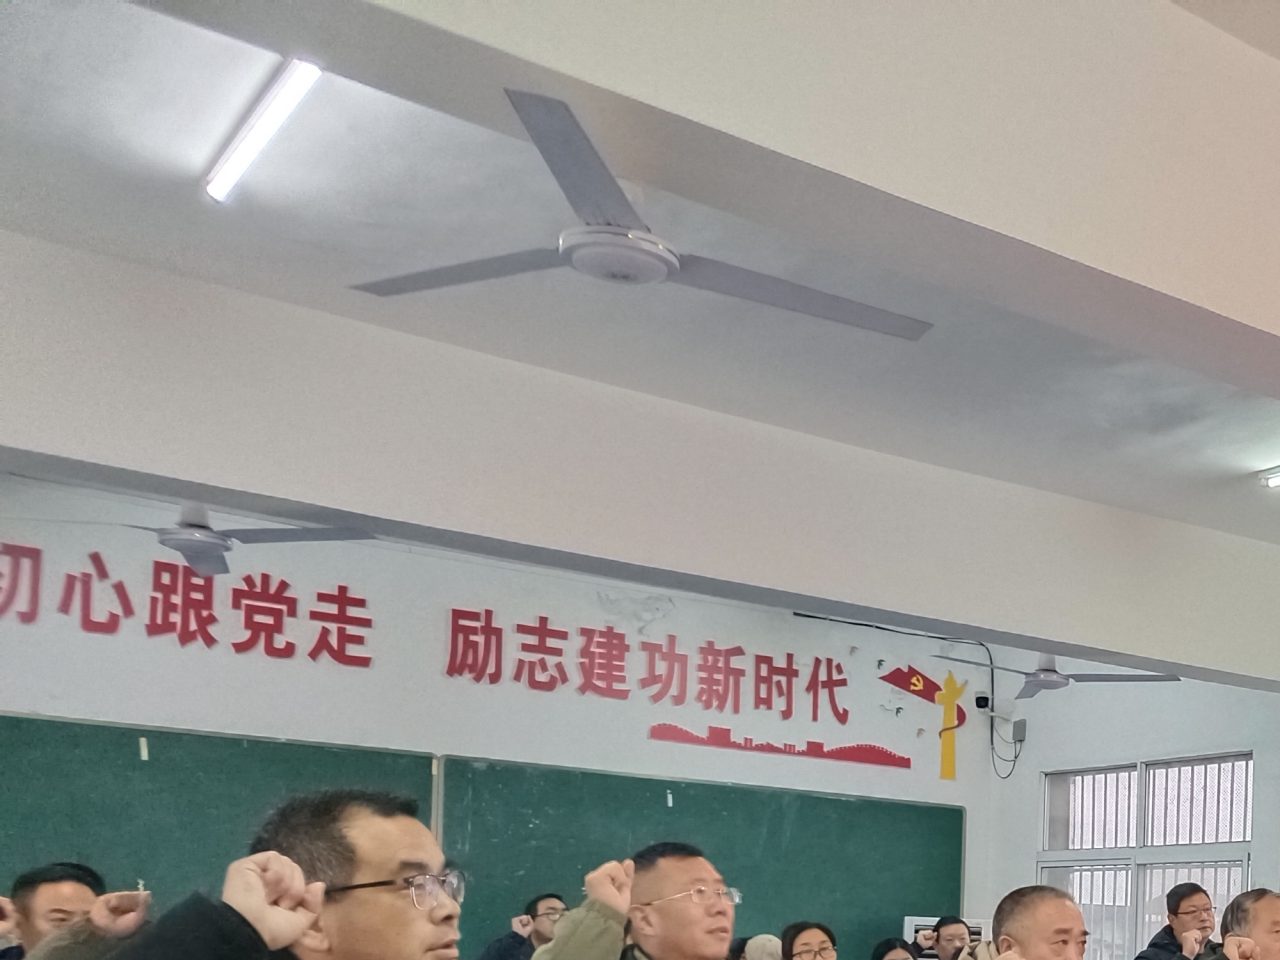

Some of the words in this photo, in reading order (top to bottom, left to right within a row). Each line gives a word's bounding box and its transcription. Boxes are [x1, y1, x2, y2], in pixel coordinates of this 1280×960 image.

[445, 607, 850, 726] 励志建功新时代
